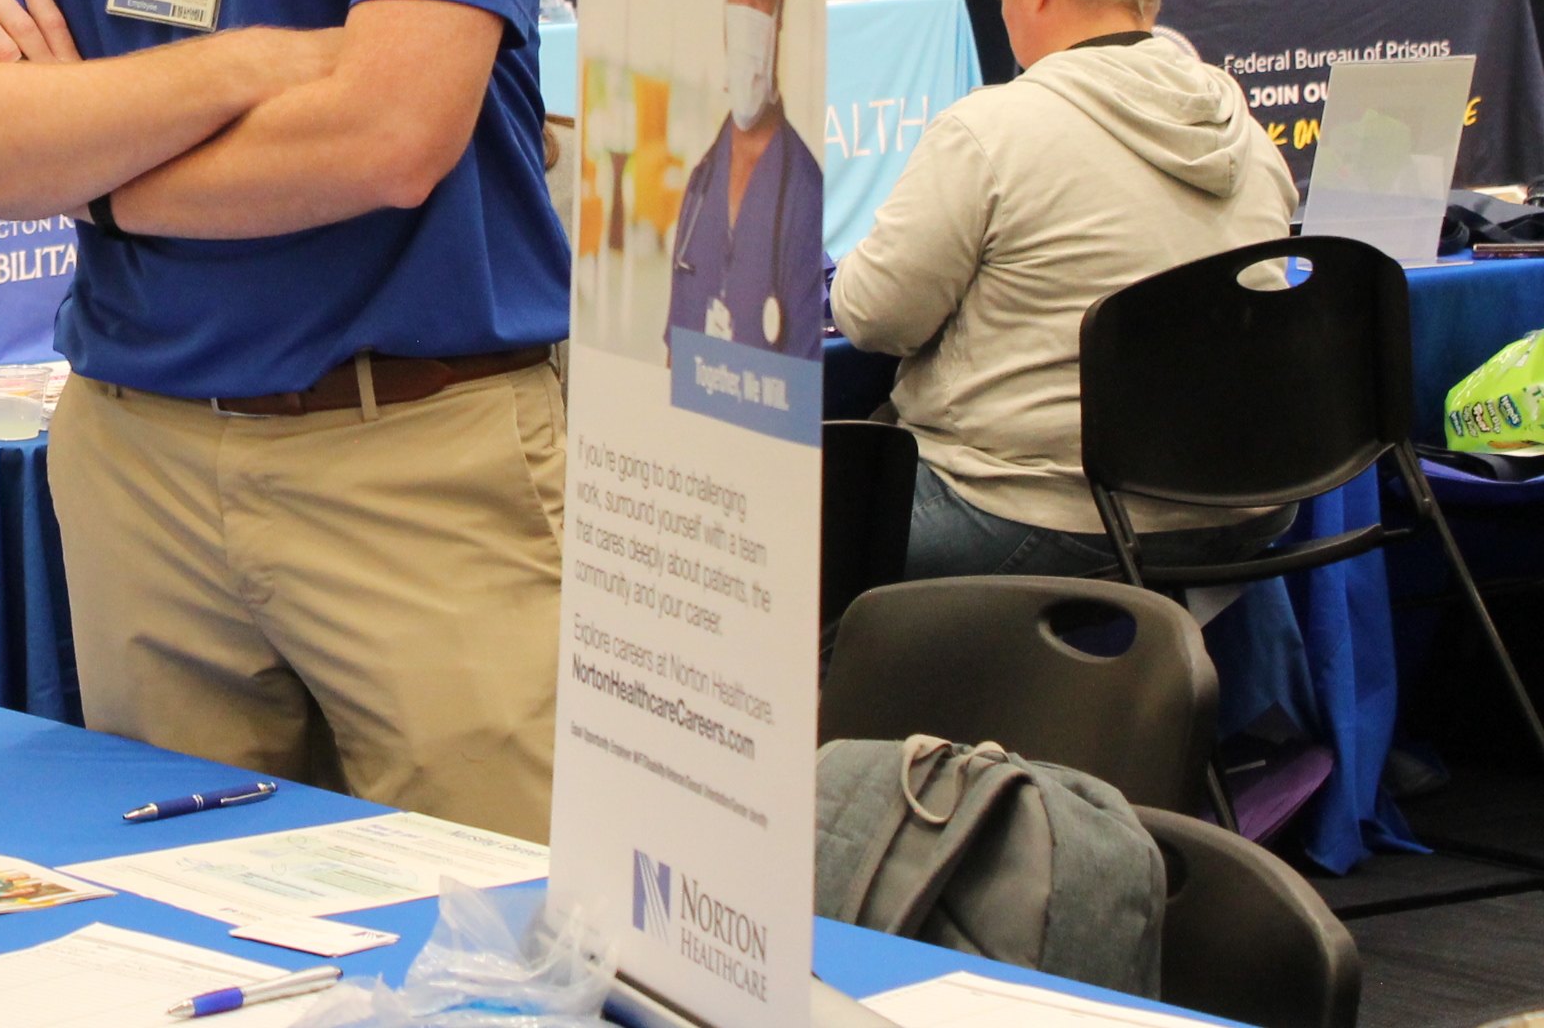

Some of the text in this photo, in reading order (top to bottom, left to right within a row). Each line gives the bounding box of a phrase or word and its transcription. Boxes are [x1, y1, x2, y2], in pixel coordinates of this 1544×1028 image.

[1224, 39, 1451, 74] Federal Bureau of Prisons
[1250, 83, 1299, 108] JOIN
[577, 481, 767, 567] work, surround yourself with a team
[618, 453, 650, 490] going
[652, 460, 665, 488] to
[667, 464, 683, 493] do
[685, 471, 747, 523] challenging
[575, 559, 630, 606] community
[633, 581, 656, 609] and
[657, 592, 683, 619] your
[576, 514, 593, 545] that
[596, 528, 625, 557] cares
[628, 534, 664, 577] deeply
[668, 549, 701, 585] about
[752, 580, 771, 613] the
[574, 612, 611, 652] Explore
[614, 636, 653, 672] careers
[657, 651, 667, 678] at
[669, 652, 710, 695] Norton
[573, 652, 755, 761] NortonHealthcareCareers.com
[680, 873, 768, 966] NORTON
[681, 926, 768, 1003] HEALTHCARE
